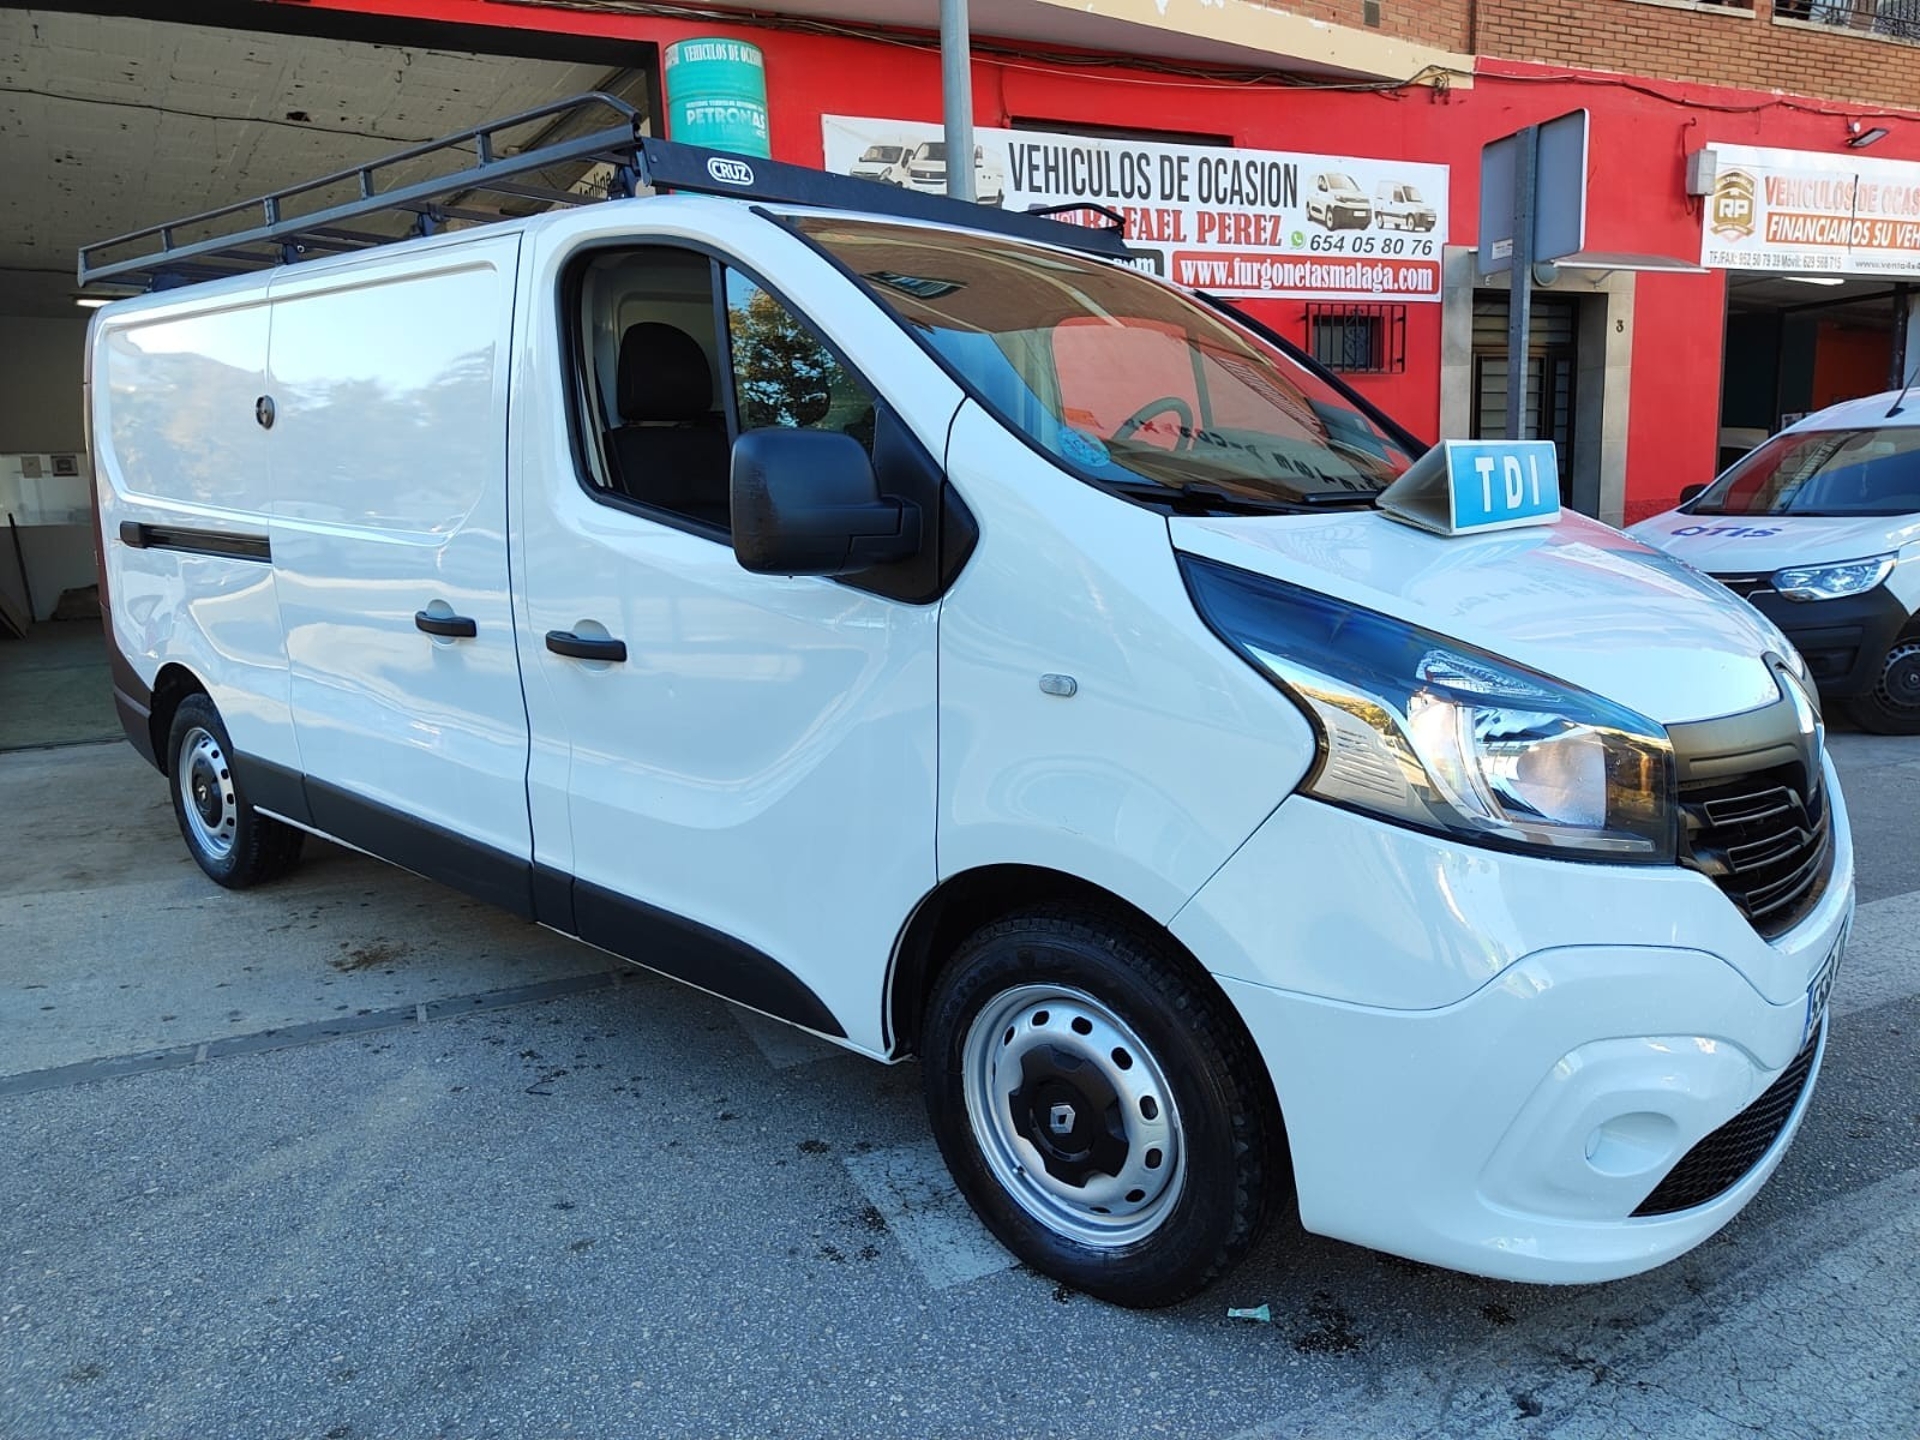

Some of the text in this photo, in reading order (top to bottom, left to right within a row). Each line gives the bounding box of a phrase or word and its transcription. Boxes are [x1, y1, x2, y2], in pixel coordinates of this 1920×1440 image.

[684, 43, 727, 62] VEHICULOS
[686, 107, 766, 130] PETRONAS
[711, 161, 750, 181] CRUZ
[1008, 142, 1298, 209] VEHICULOS DE OCASION
[1764, 175, 1854, 213] VEHICULOS
[1857, 183, 1879, 213] DE
[1719, 199, 1749, 218] RP
[1196, 210, 1282, 247] PEREZ
[1768, 215, 1871, 247] FINANCIAMOS
[1872, 221, 1893, 248] SU
[1310, 236, 1434, 256] 654 05 80 76
[1179, 257, 1434, 293] www.furgonetasmalaga.com
[1615, 319, 1624, 333] 3
[1474, 454, 1540, 513] TDI
[1671, 526, 1783, 538] OTIS
